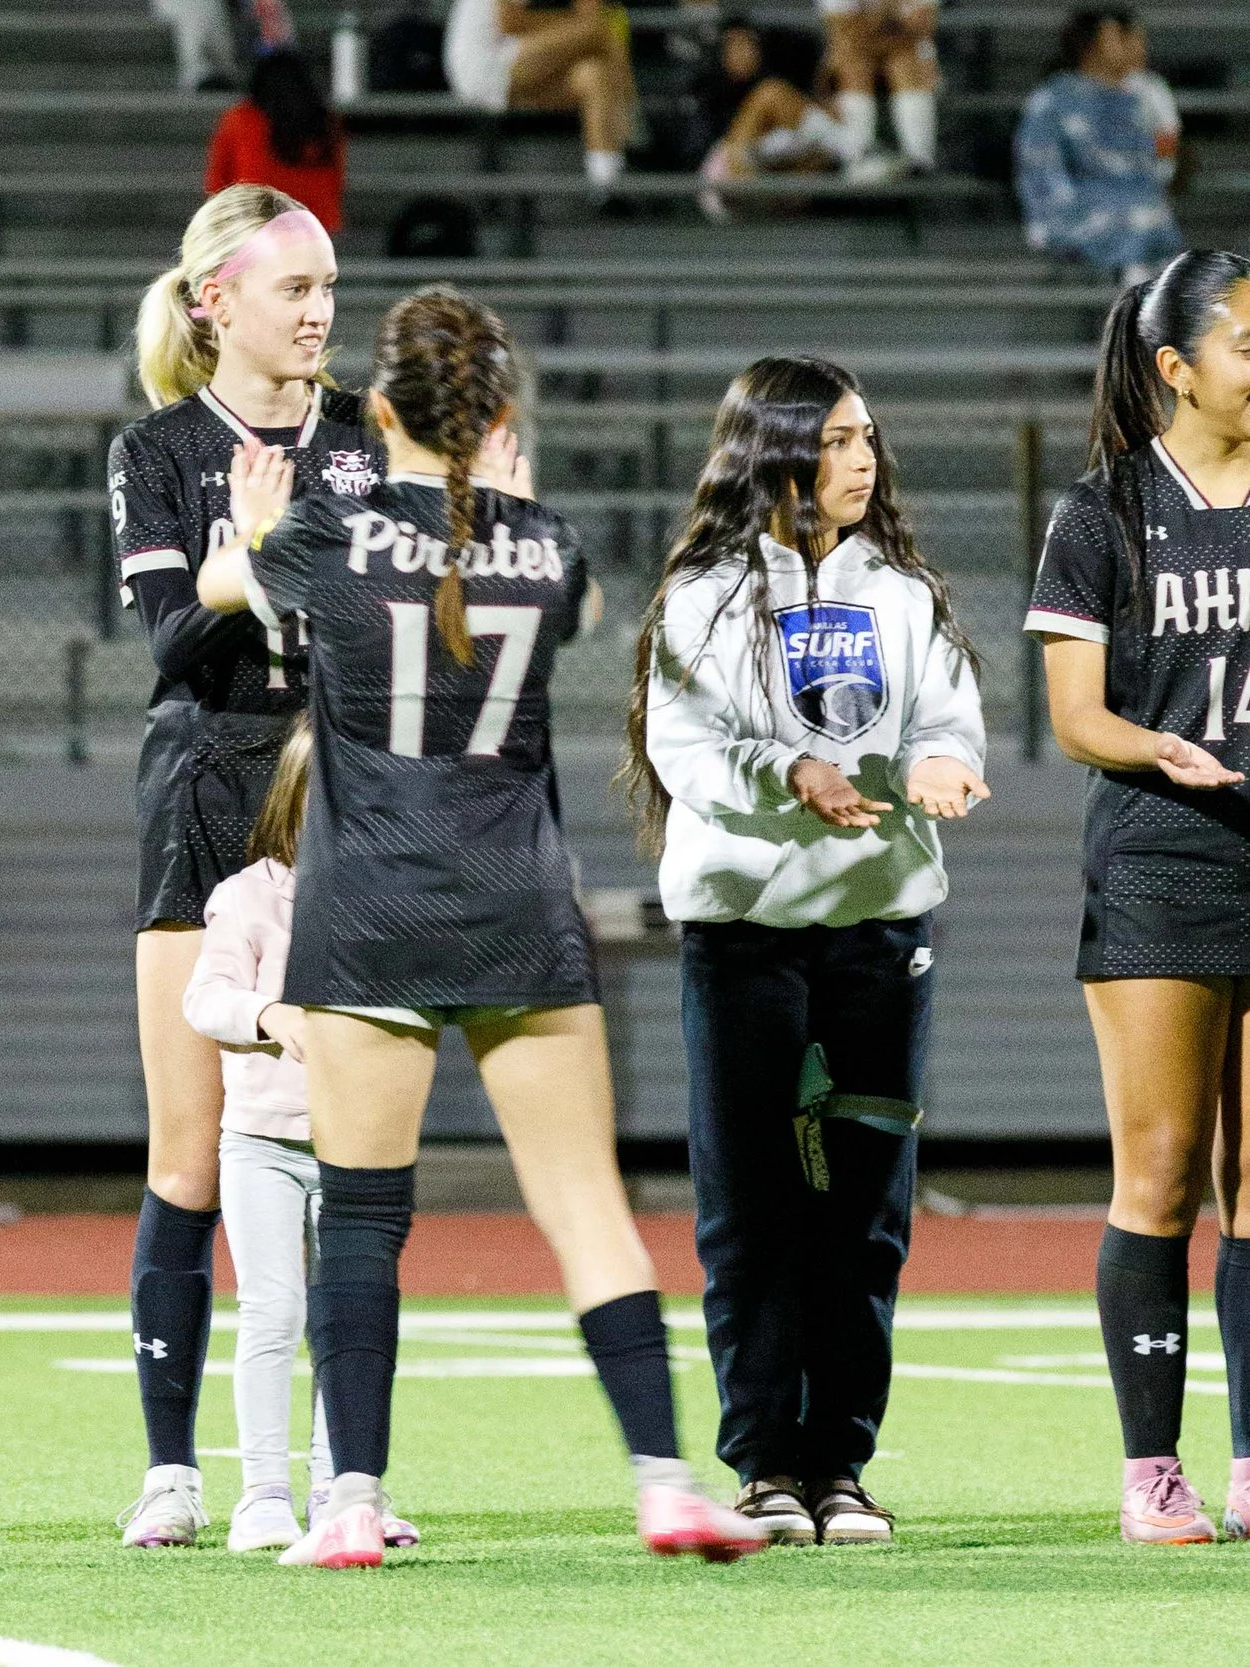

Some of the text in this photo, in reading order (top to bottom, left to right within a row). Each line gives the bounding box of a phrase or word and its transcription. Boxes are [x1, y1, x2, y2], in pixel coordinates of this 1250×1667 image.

[341, 510, 563, 583] Pirates
[1151, 567, 1250, 637] AH
[386, 600, 542, 758] 17
[787, 631, 874, 658] SURF
